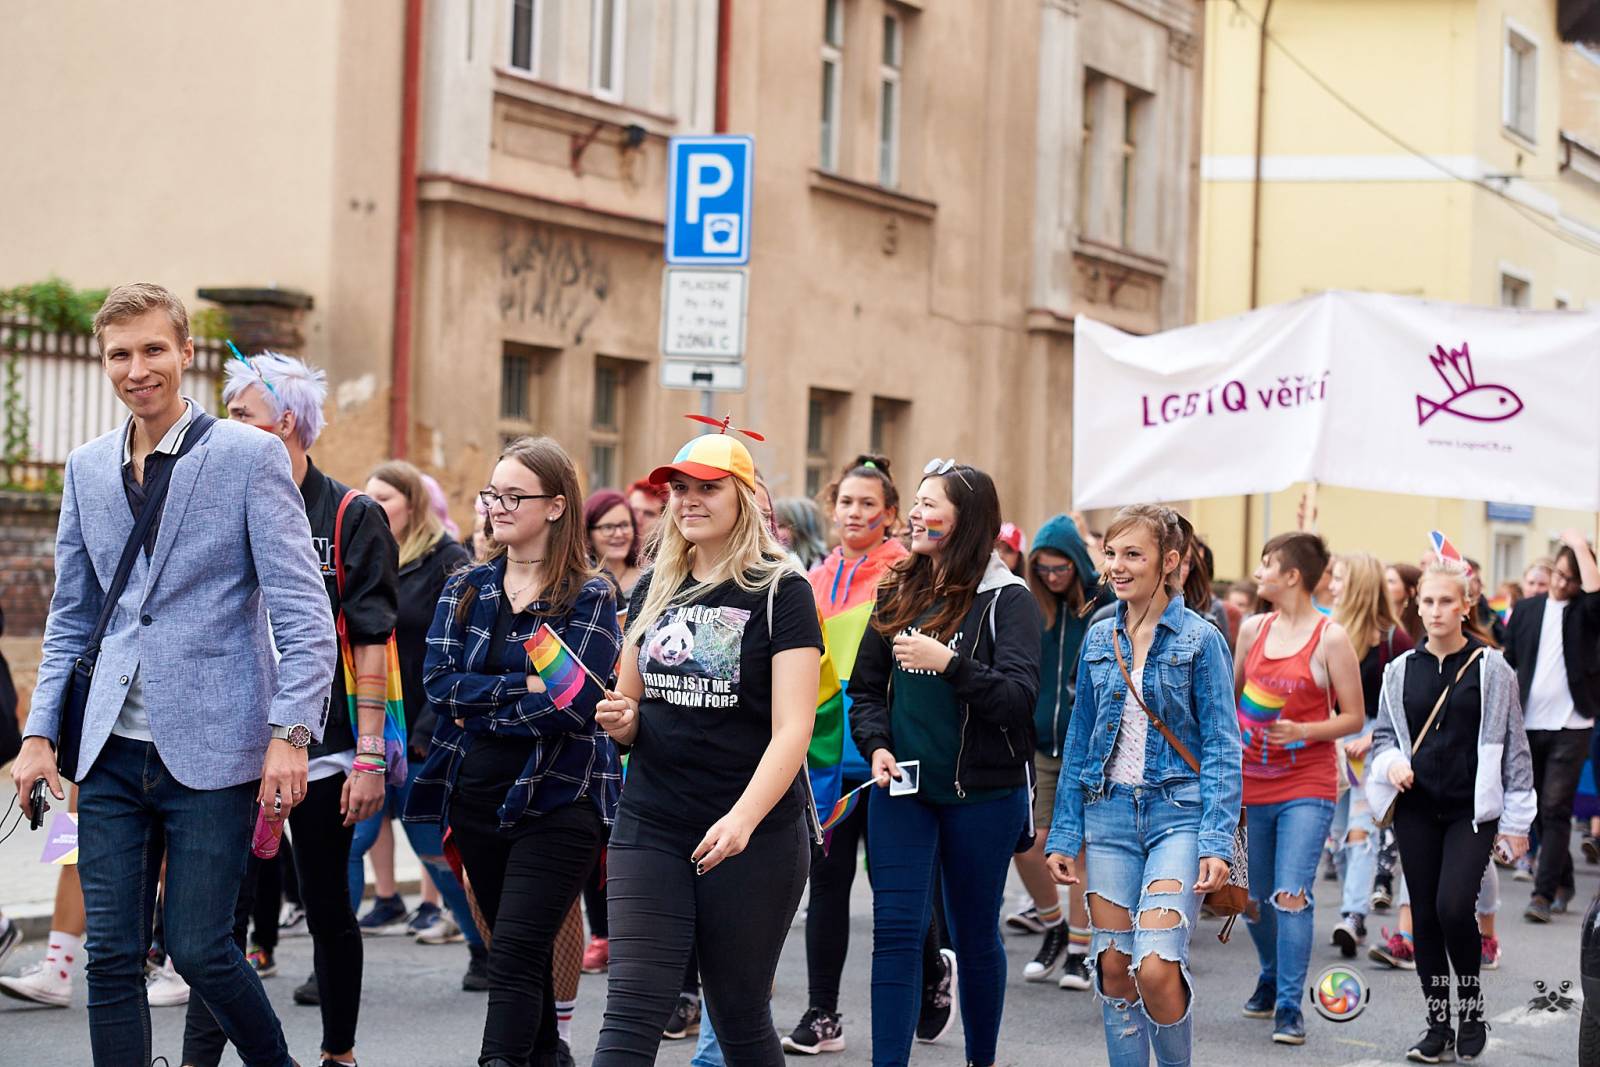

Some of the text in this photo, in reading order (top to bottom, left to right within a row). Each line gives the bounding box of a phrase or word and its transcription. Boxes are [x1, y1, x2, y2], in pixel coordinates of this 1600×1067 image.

[685, 152, 734, 224] P
[1142, 380, 1248, 427] LGBTQ
[661, 689, 703, 707] LOOKIN
[705, 694, 738, 708] FOR?
[683, 676, 696, 690] IS
[699, 678, 710, 691] IT
[712, 679, 731, 693] ME
